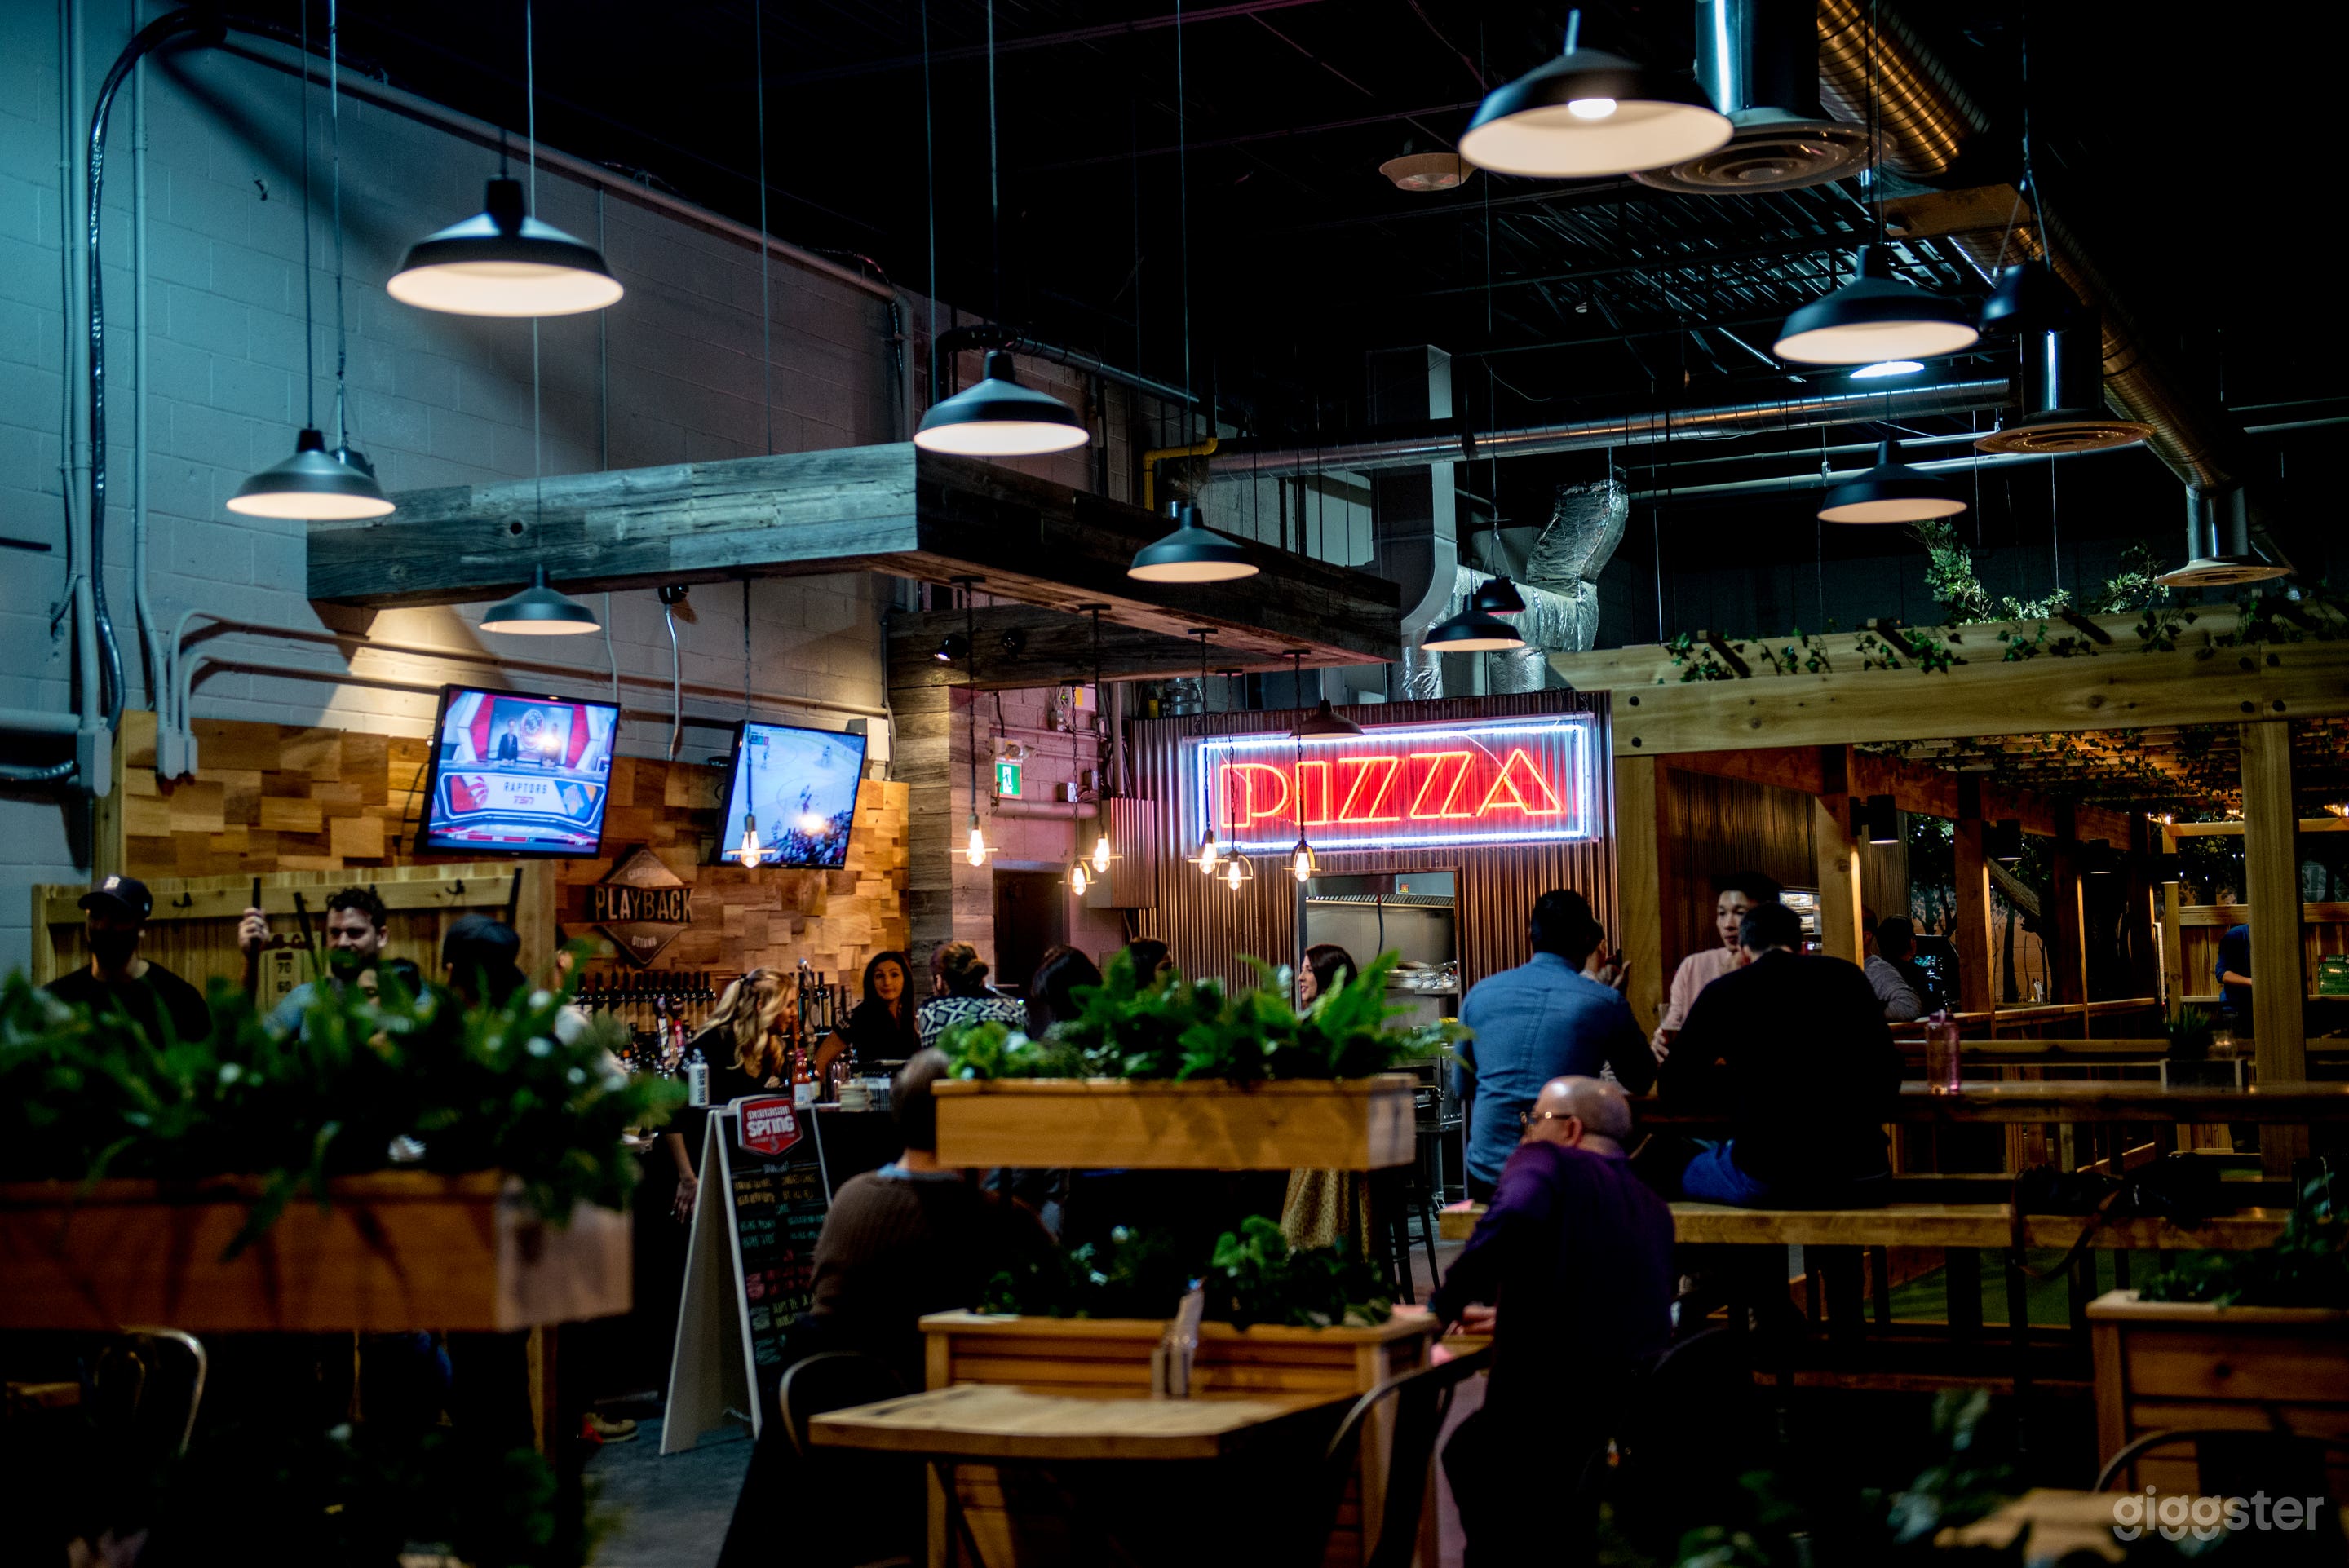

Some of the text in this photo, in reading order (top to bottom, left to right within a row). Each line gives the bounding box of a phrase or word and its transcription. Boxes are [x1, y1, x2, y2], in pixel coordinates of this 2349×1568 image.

[504, 781, 547, 794] RAPTORS
[1220, 747, 1563, 828] PIZZA
[594, 886, 693, 922] PLAYBACK
